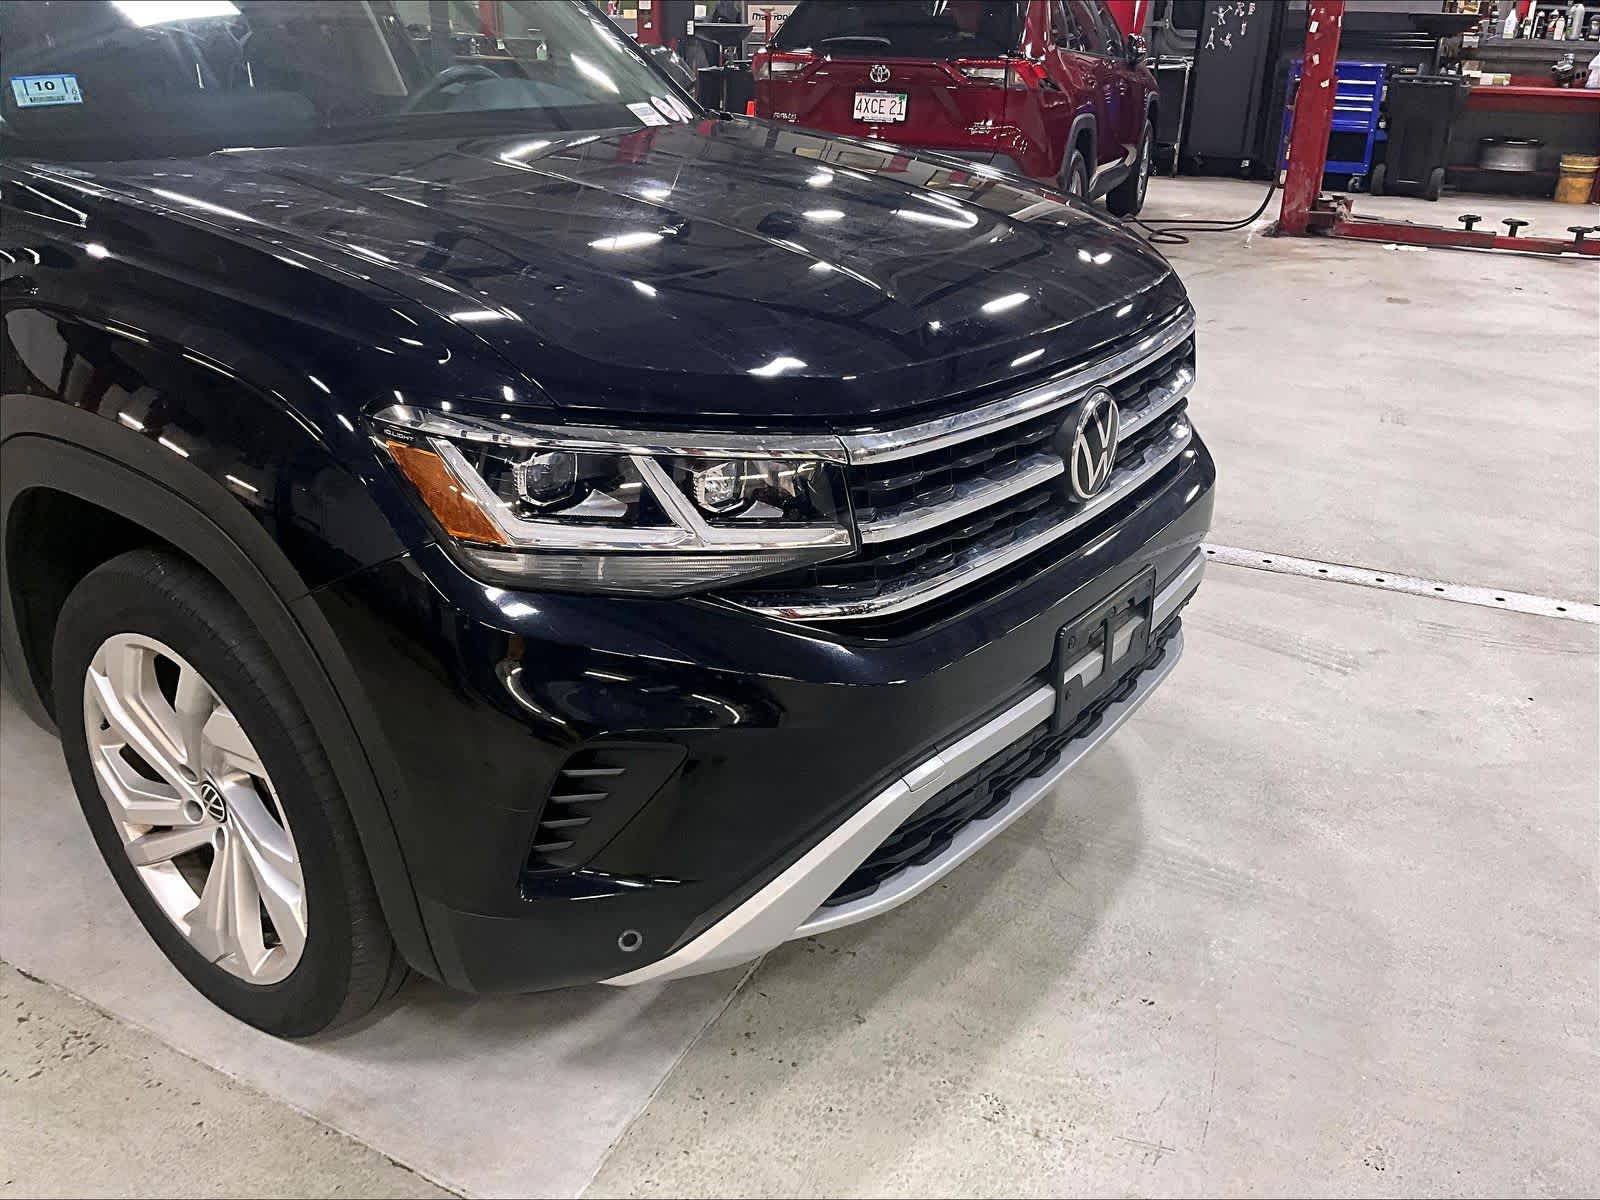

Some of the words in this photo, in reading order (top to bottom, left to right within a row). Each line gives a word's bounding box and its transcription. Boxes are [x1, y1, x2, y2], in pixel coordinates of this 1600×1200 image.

[34, 80, 55, 91] 10
[856, 98, 886, 114] 4XCE
[889, 99, 904, 116] 21
